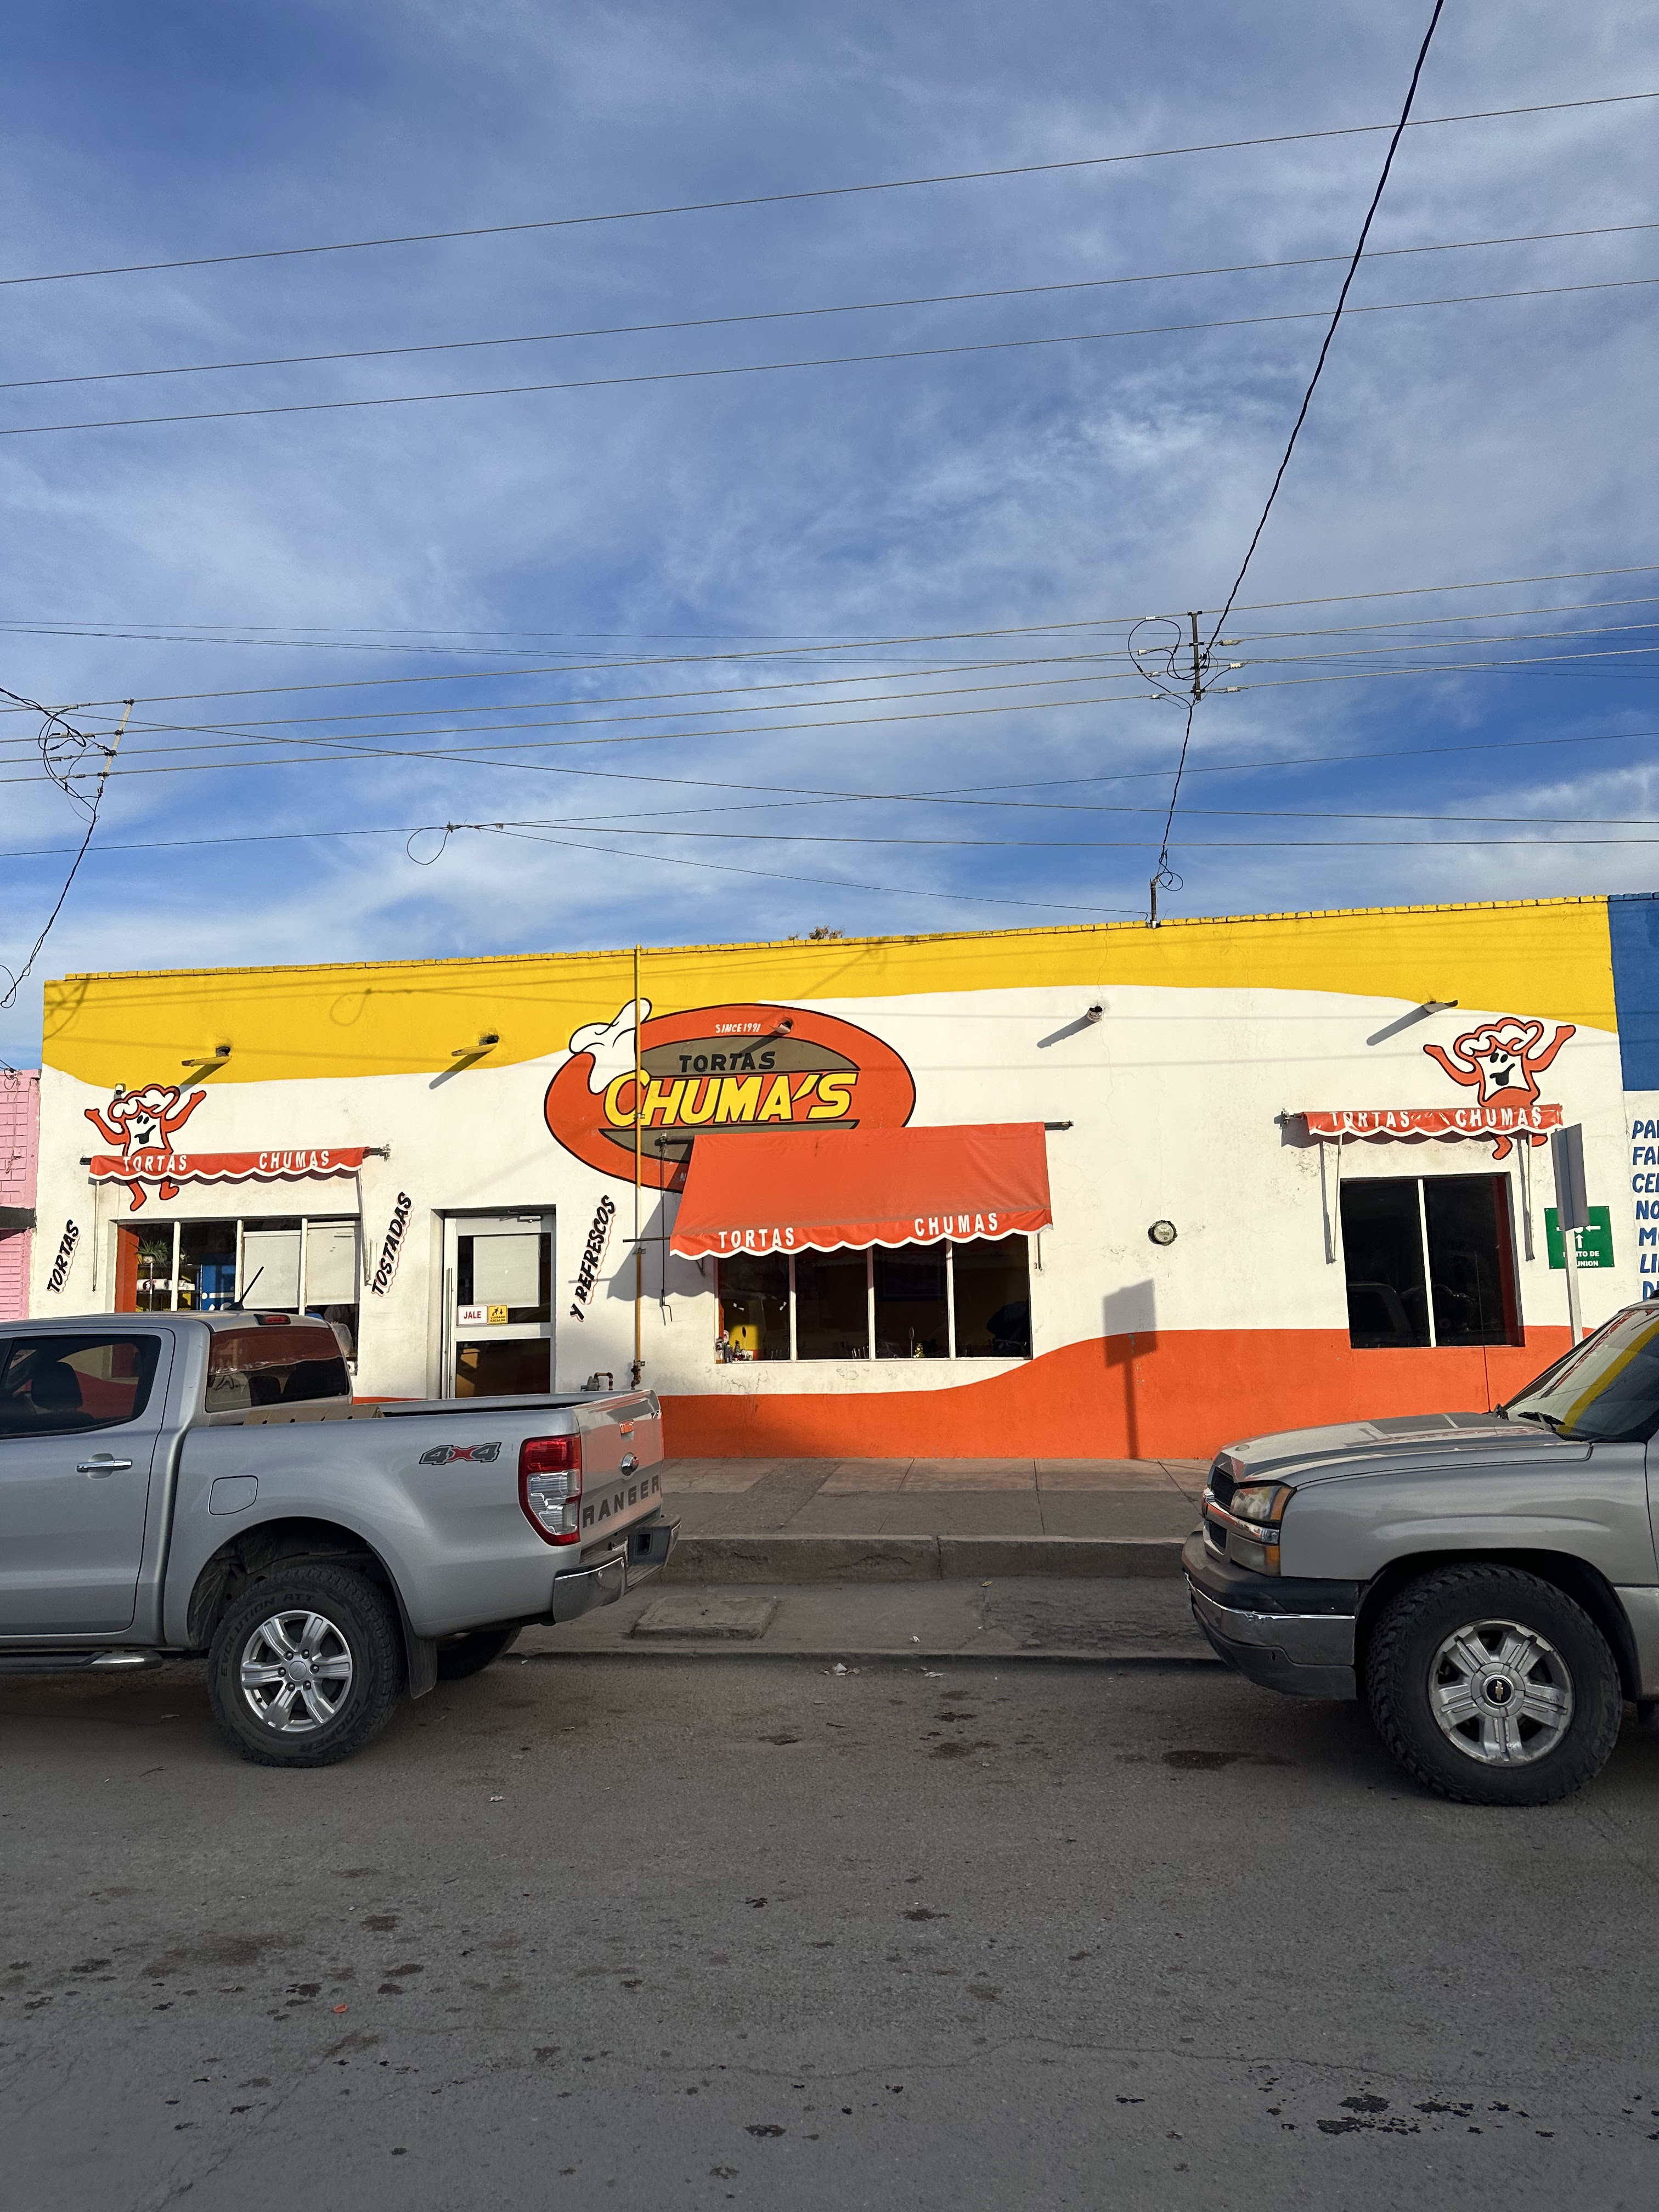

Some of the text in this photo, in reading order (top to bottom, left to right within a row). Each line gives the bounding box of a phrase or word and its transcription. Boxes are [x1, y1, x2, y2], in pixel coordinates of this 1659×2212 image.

[715, 1023, 761, 1034] SINCE 1991
[679, 1051, 776, 1073] TORTAS
[603, 1069, 859, 1127] CHUMA'S
[1328, 1107, 1543, 1128] TORTAS CHUMAS
[1631, 1119, 1659, 1139] PA
[122, 1150, 330, 1172] TORTAS CHUMAS
[1632, 1146, 1659, 1165] FA
[718, 1212, 998, 1250] TORTAS CHUMAS
[371, 1191, 412, 1295] TOSTADAS
[46, 1219, 80, 1293] TORTAS
[569, 1194, 616, 1321] Y REFRESCOS
[1640, 1253, 1659, 1273] LI
[463, 1311, 482, 1319] JALE
[582, 1474, 659, 1528] RANGER
[220, 1596, 275, 1678] EVOLUTION
